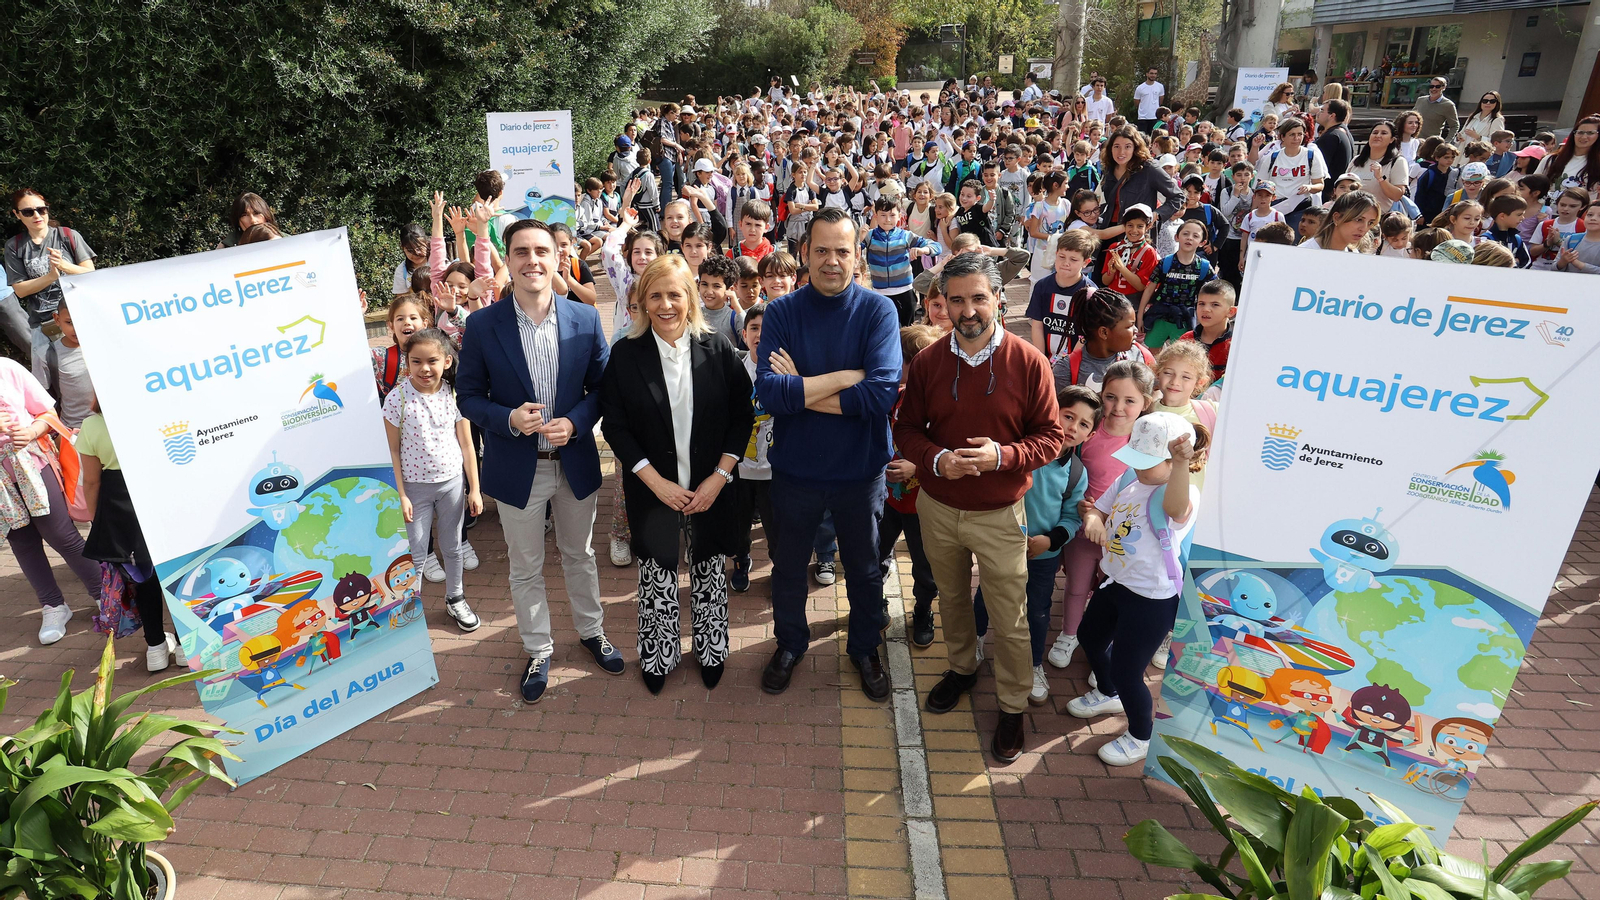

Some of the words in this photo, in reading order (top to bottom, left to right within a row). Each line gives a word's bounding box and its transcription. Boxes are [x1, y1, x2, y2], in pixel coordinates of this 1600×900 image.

[500, 123, 521, 131] Diario
[523, 122, 532, 130] de
[533, 122, 550, 132] Jerez
[502, 143, 553, 155] aquajerez
[1166, 272, 1200, 280] MINECRAF
[121, 292, 197, 325] Diario
[202, 283, 233, 308] de
[235, 275, 293, 307] Jerez
[1292, 286, 1383, 321] Diario
[1390, 297, 1432, 327] de
[1434, 304, 1530, 340] Jerez
[1555, 326, 1574, 336] 40
[144, 334, 312, 393] aquajerez
[1276, 366, 1510, 423] aquajerez
[282, 400, 338, 426] BIODIVERSIDAD
[197, 415, 258, 437] Ayuntamiento
[212, 431, 234, 444] Jerez
[1299, 454, 1312, 463] de
[1314, 456, 1344, 469] Jerez
[1301, 444, 1383, 466] Ayuntamiento
[1409, 481, 1499, 507] BIODIVERSIDAD
[1411, 477, 1470, 492] CONSERVACIÓN
[1407, 491, 1448, 502] ZOOBOTÁNICO
[254, 714, 298, 743] Día
[303, 690, 339, 720] del
[346, 661, 405, 700] Agua
